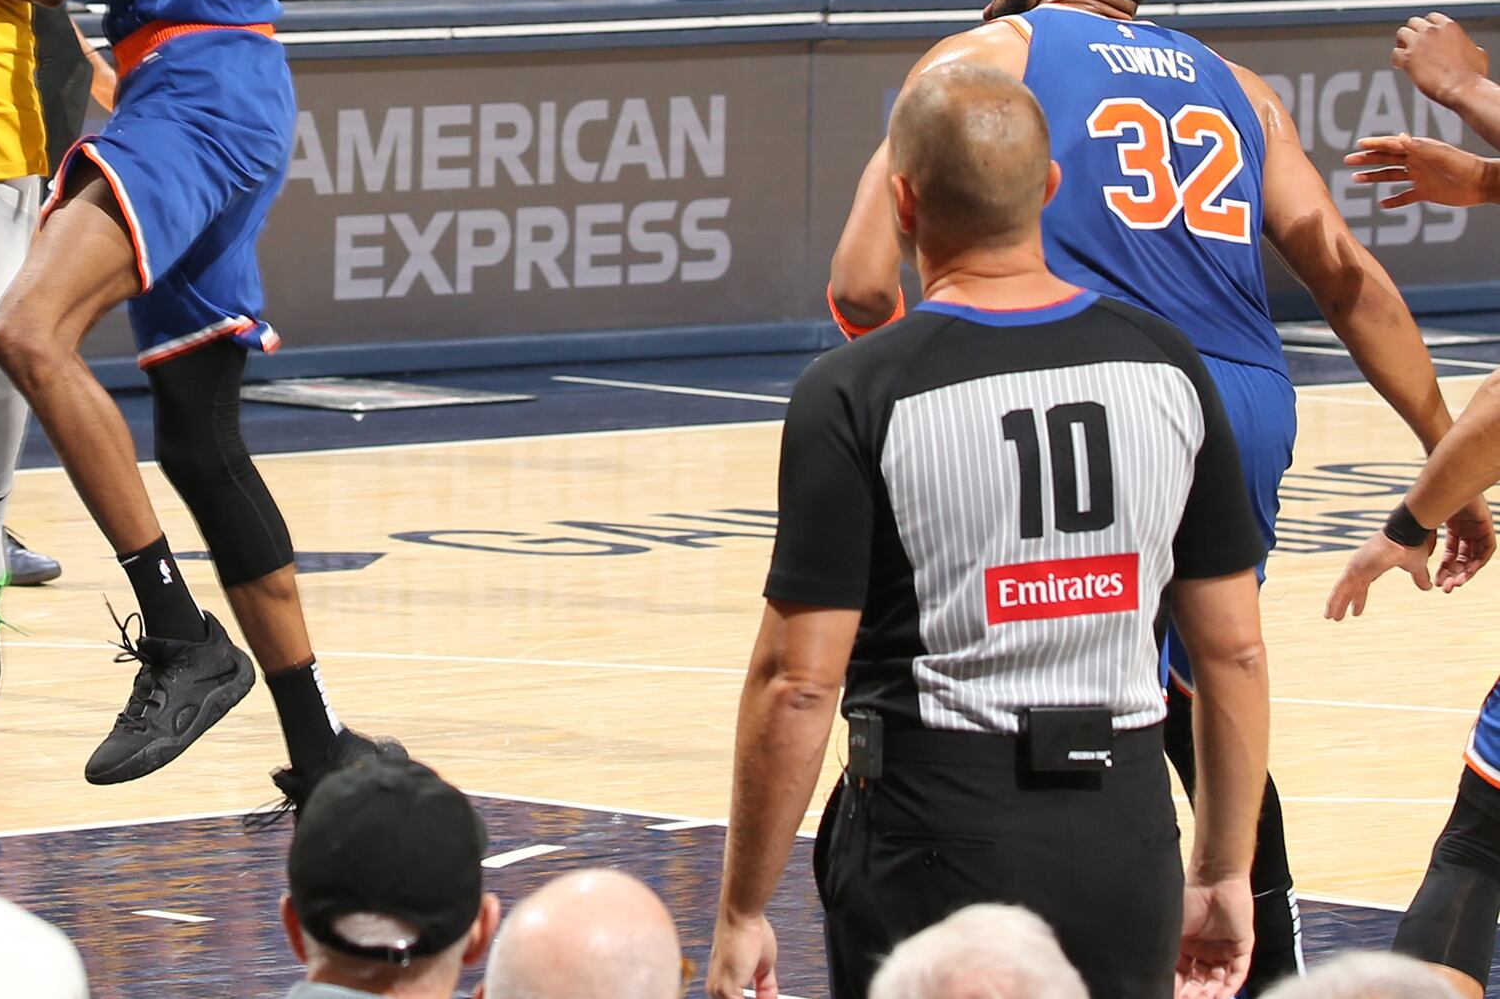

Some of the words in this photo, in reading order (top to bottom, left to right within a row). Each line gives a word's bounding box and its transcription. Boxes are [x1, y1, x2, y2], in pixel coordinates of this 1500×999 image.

[1089, 41, 1197, 84] TOWNS
[284, 94, 727, 197] AMERICAN
[1086, 96, 1252, 245] 32
[333, 197, 733, 301] EXPRESS
[1001, 400, 1116, 540] 10
[997, 572, 1125, 609] Emirates
